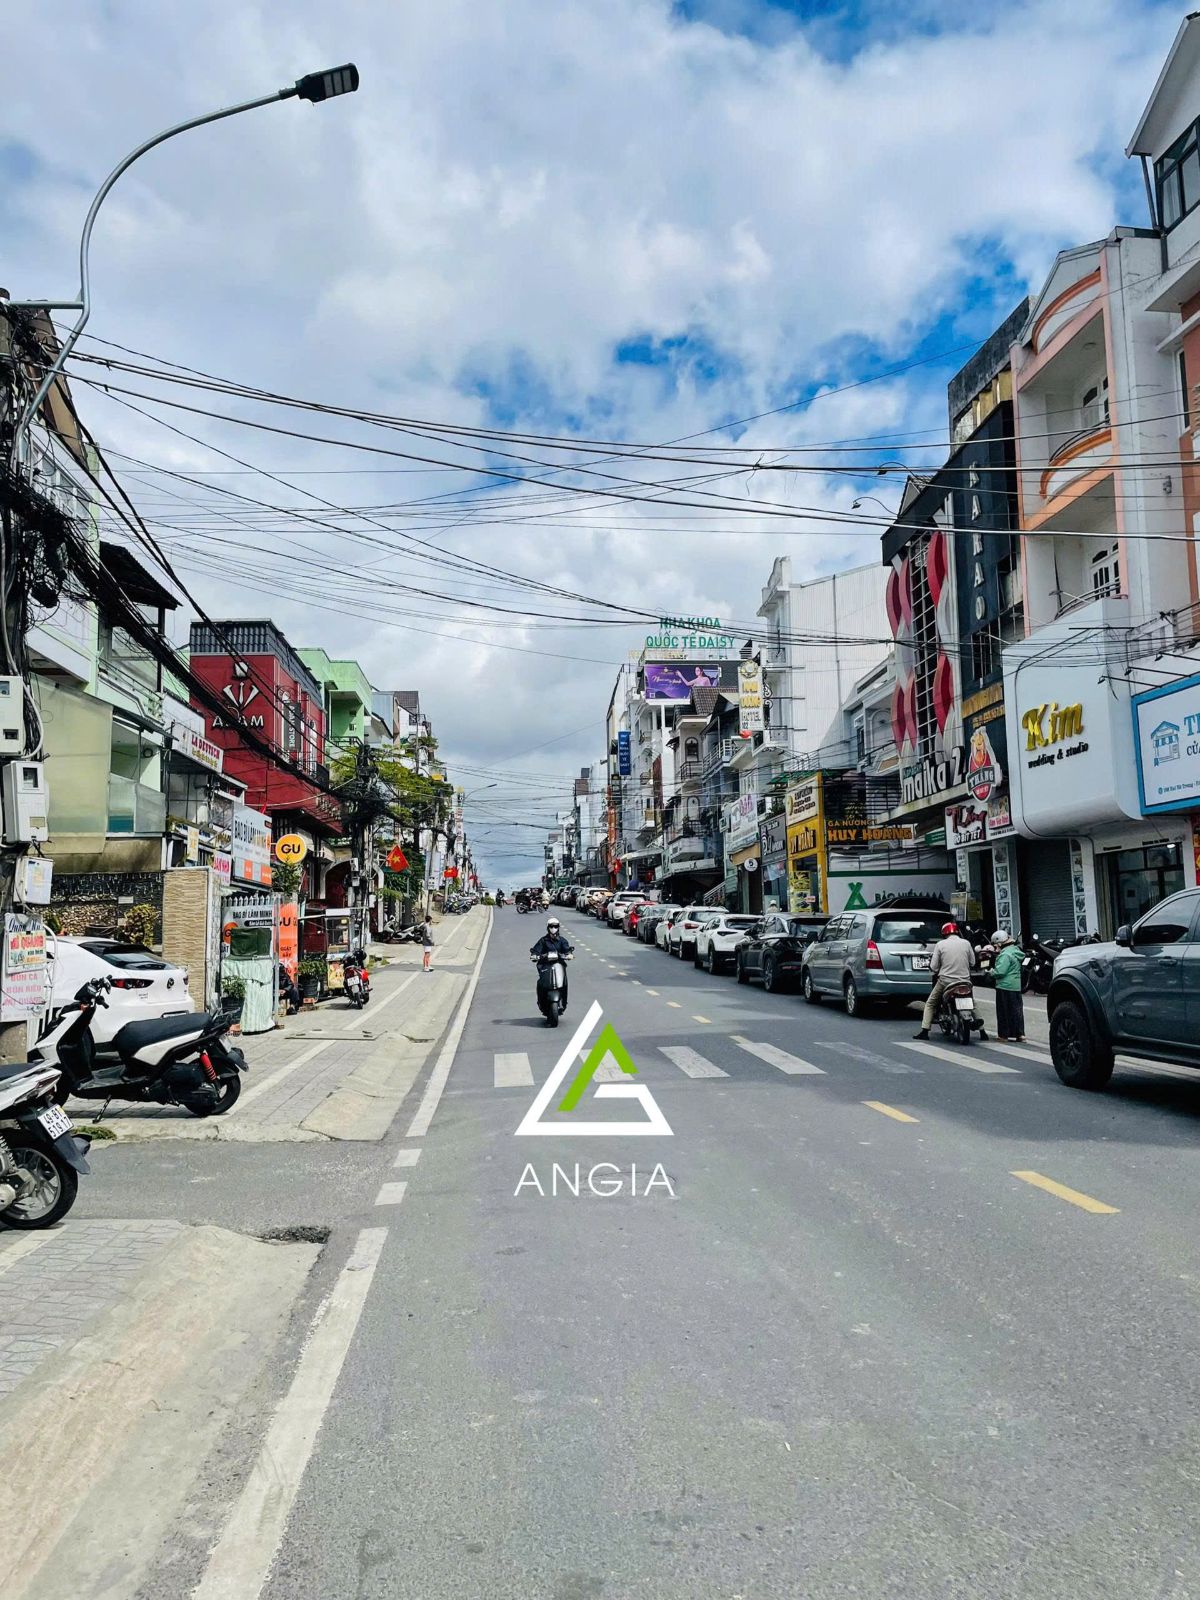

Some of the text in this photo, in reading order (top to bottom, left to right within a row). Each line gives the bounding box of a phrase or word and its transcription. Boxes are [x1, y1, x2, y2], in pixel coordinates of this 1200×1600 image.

[646, 630, 735, 648] QUỐC TẾ DAISY
[1022, 703, 1084, 751] Kim
[1028, 741, 1089, 769] wedding & studio
[903, 759, 947, 804] maika
[828, 828, 860, 841] HUY
[281, 844, 301, 854] GU
